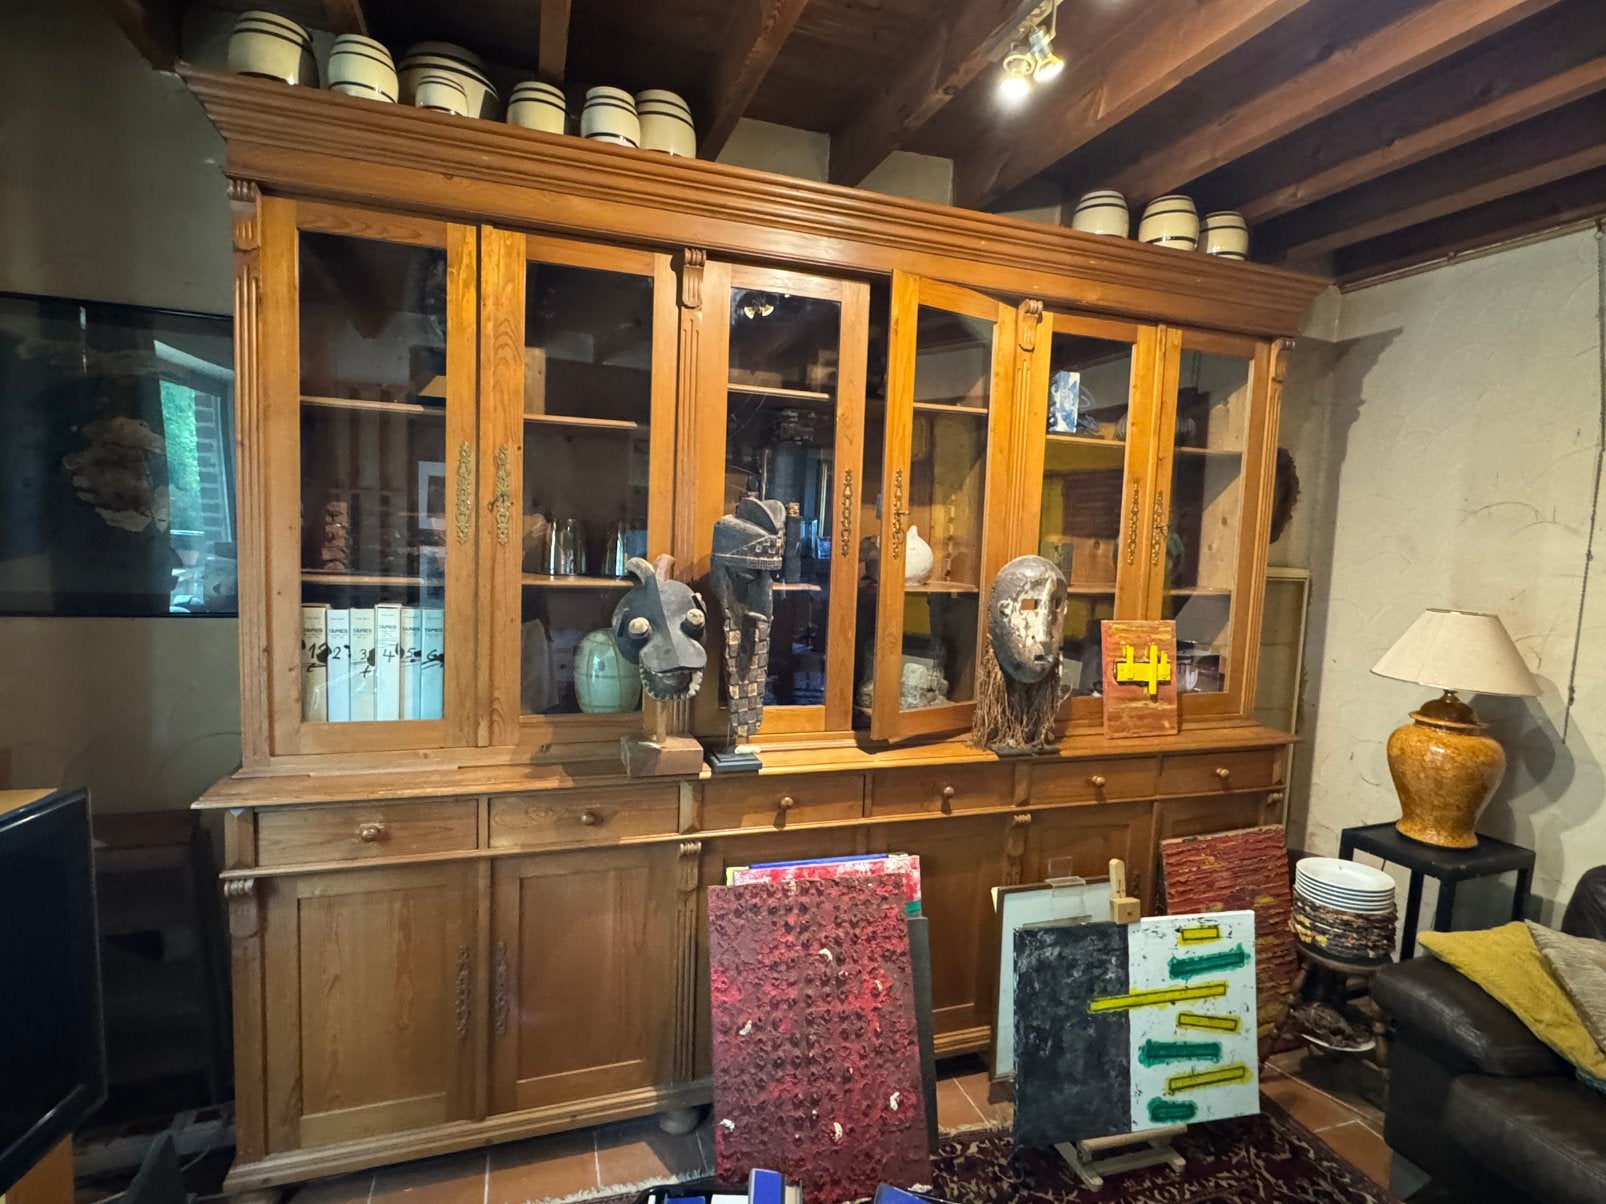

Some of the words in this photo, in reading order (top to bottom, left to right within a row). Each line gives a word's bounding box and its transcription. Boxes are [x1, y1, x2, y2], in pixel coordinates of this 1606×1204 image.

[332, 646, 342, 660] 2
[359, 648, 368, 661] 3
[382, 648, 396, 663] 4
